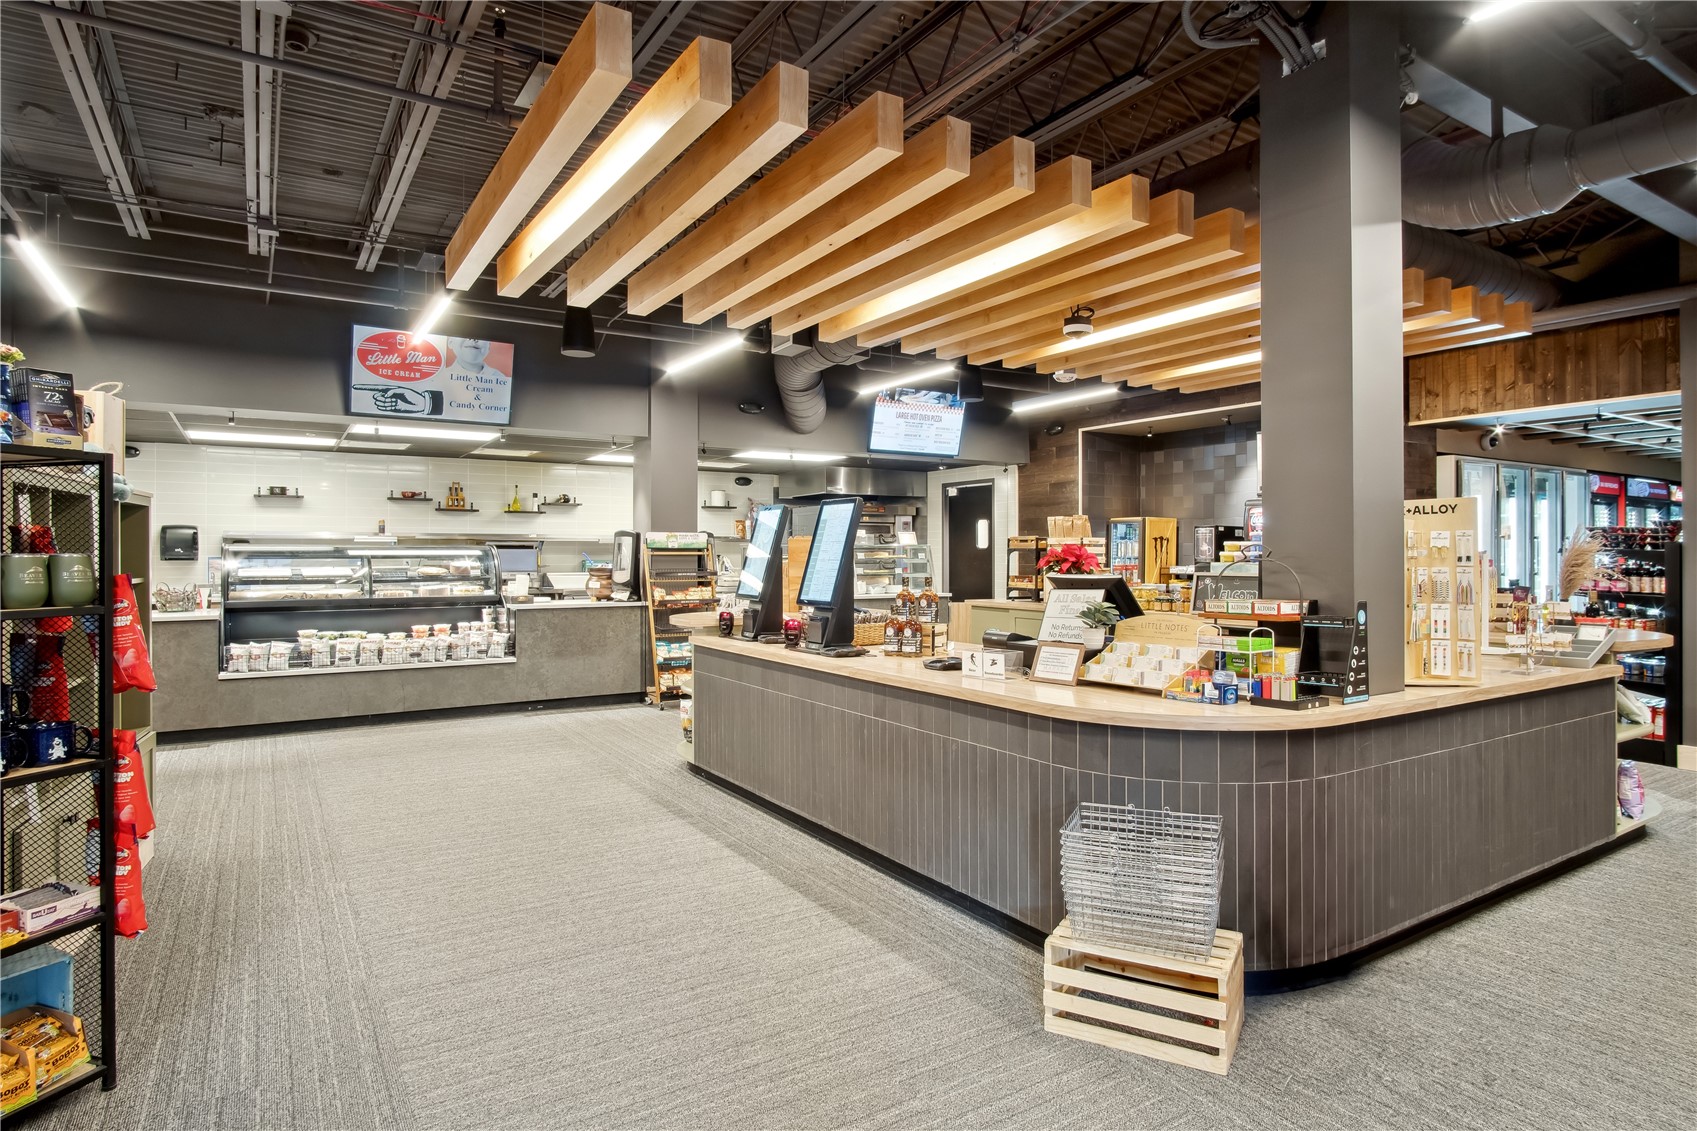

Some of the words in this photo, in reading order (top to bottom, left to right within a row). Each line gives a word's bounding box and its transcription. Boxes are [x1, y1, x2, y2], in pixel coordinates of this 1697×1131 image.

[366, 352, 401, 365] Little
[405, 351, 437, 364] Man
[379, 368, 392, 376] ICE
[394, 369, 421, 378] CREAM
[31, 377, 70, 385] GHIRARDELLI
[450, 373, 473, 383] Little
[475, 375, 493, 385] Man
[495, 377, 508, 386] Ice
[465, 384, 493, 393] Cream
[474, 393, 481, 401] &
[449, 400, 475, 411] Candy
[478, 402, 508, 412] Corner
[896, 412, 909, 420] LARGE
[910, 413, 918, 421] HOT
[931, 415, 942, 423] PIZZA
[1054, 594, 1068, 603] All
[1256, 604, 1276, 612] ALTOIDS
[1050, 623, 1060, 631] No
[1140, 622, 1162, 631] LITTLE
[1164, 623, 1188, 632] NOTES
[1048, 631, 1057, 639] No
[1058, 631, 1083, 640] Refunds
